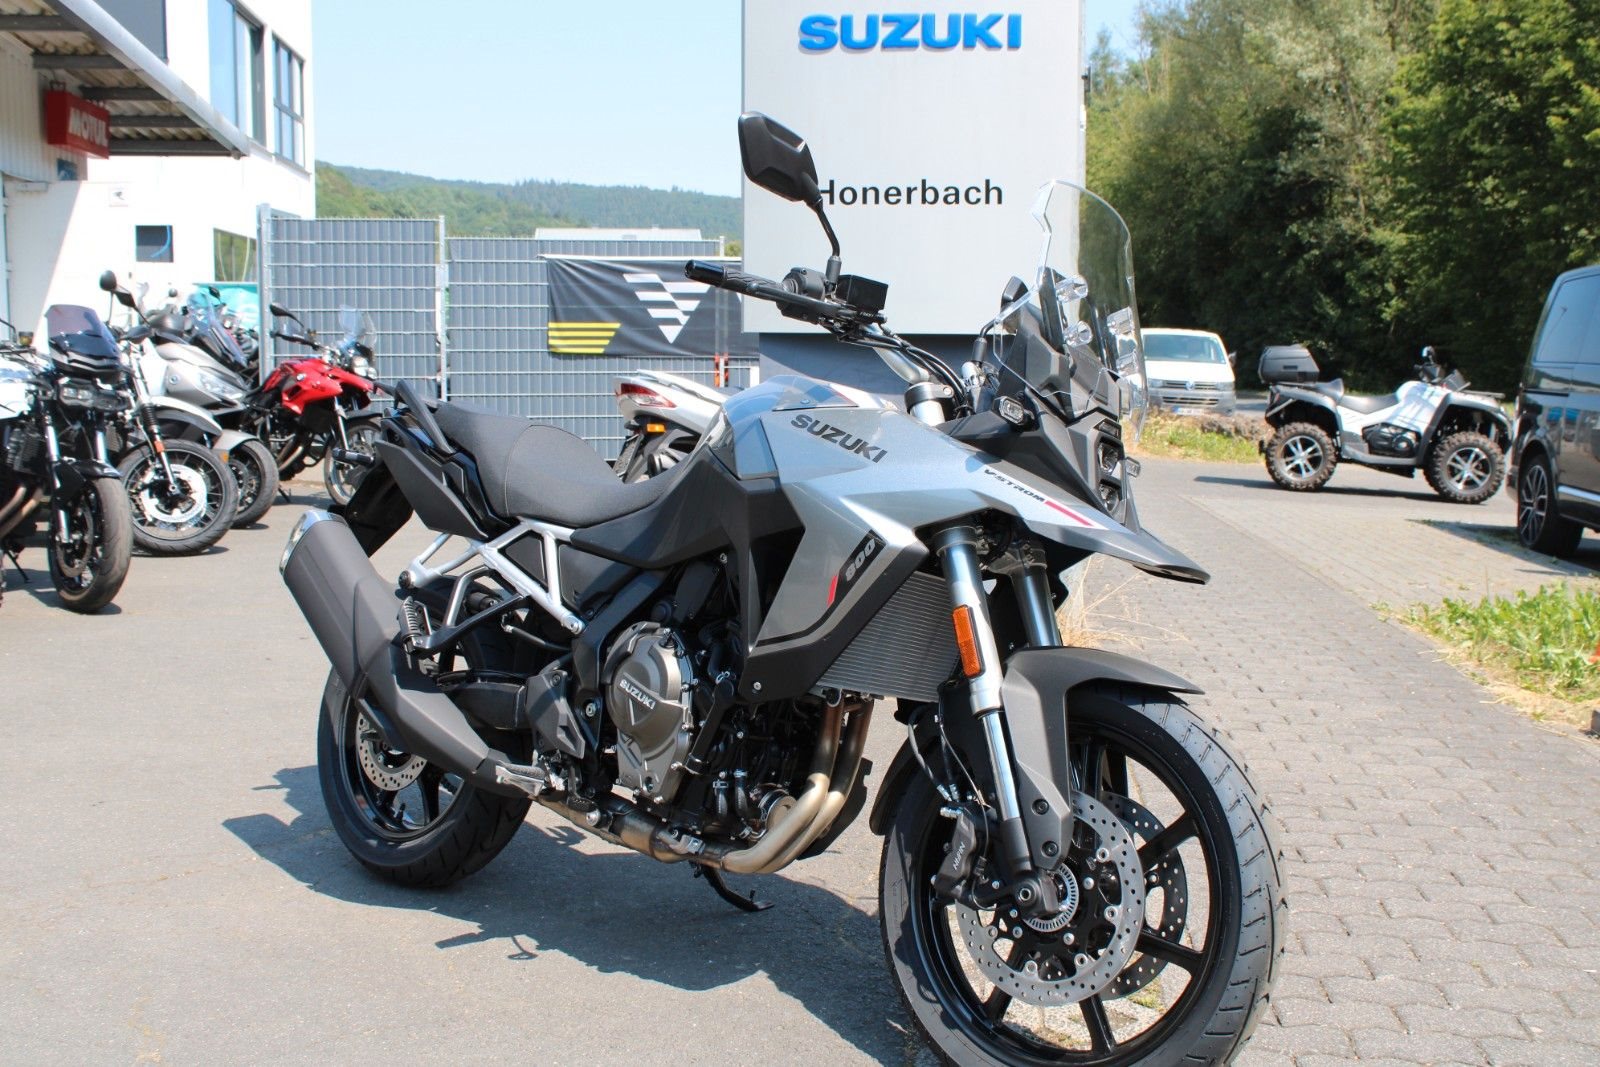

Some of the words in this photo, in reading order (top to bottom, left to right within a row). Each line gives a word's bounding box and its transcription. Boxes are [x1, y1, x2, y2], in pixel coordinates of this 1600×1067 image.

[799, 13, 1022, 50] SUZUKI
[69, 106, 108, 148] MOTUL
[790, 414, 888, 463] SUZUKI
[845, 538, 876, 582] 800
[619, 678, 656, 710] SUZUKI
